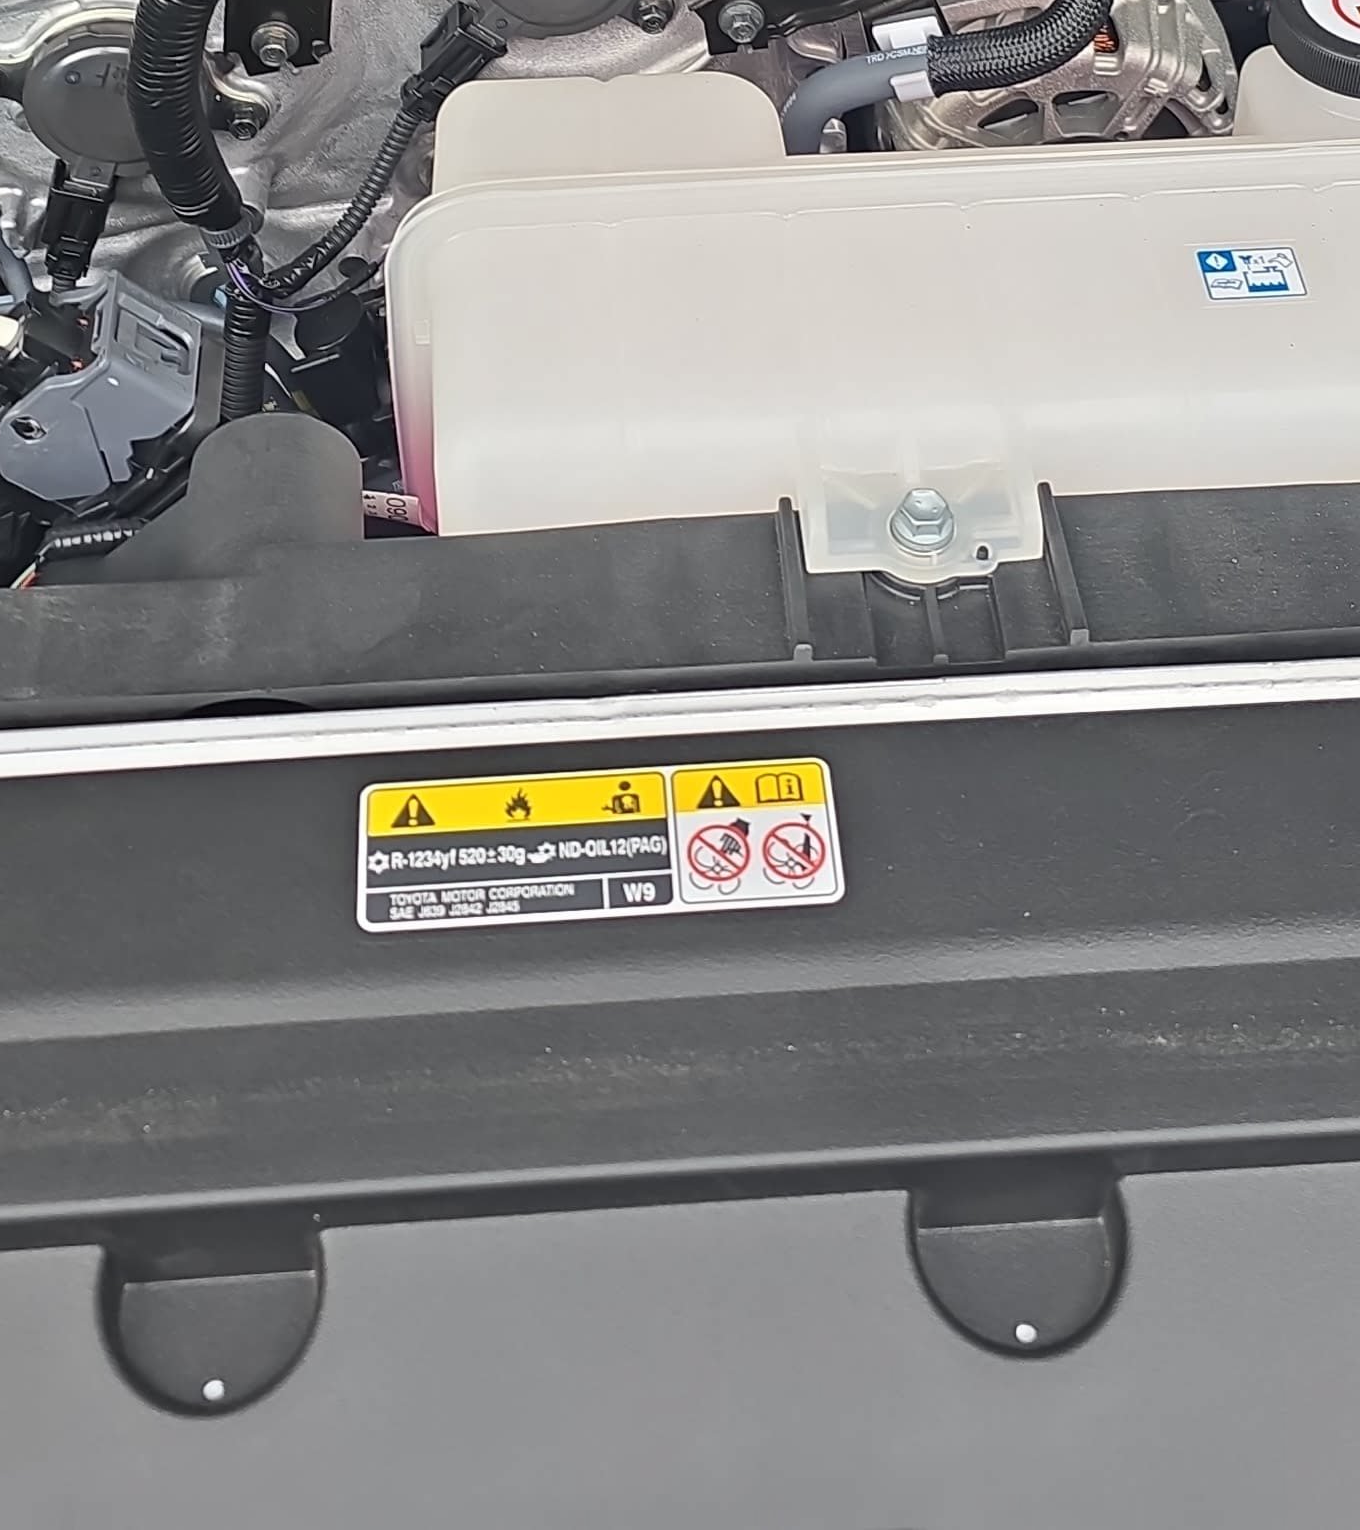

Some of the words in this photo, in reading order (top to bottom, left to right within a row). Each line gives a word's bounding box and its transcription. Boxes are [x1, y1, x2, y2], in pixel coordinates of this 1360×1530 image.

[391, 848, 457, 870] R-1234yf
[458, 844, 527, 866] 520±30g
[389, 891, 438, 906] TOYOTA
[441, 888, 487, 903] MOTOR
[488, 883, 576, 901] CORPORATION
[623, 882, 657, 903] W9
[389, 905, 416, 920] SAE
